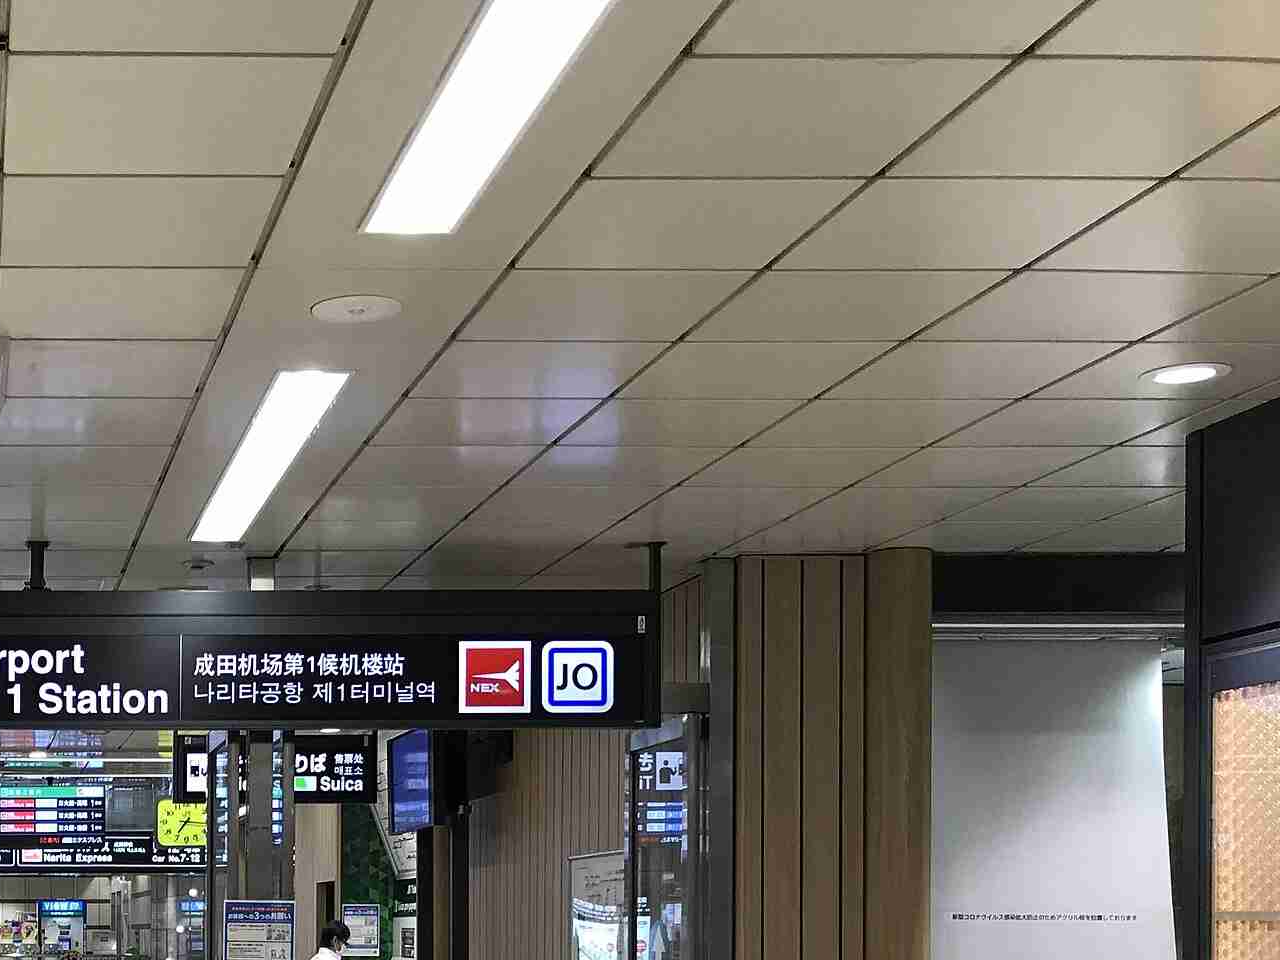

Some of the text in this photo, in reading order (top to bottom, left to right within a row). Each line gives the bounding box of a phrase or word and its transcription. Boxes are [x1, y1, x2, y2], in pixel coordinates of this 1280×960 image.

[194, 652, 405, 677] 成田机场第1候机楼站
[470, 682, 501, 693] NEX
[555, 662, 598, 692] JO
[7, 683, 23, 713] 1
[38, 682, 169, 714] Station
[194, 681, 436, 704] 나리타공항 제1터미널역
[320, 775, 363, 792] Suica
